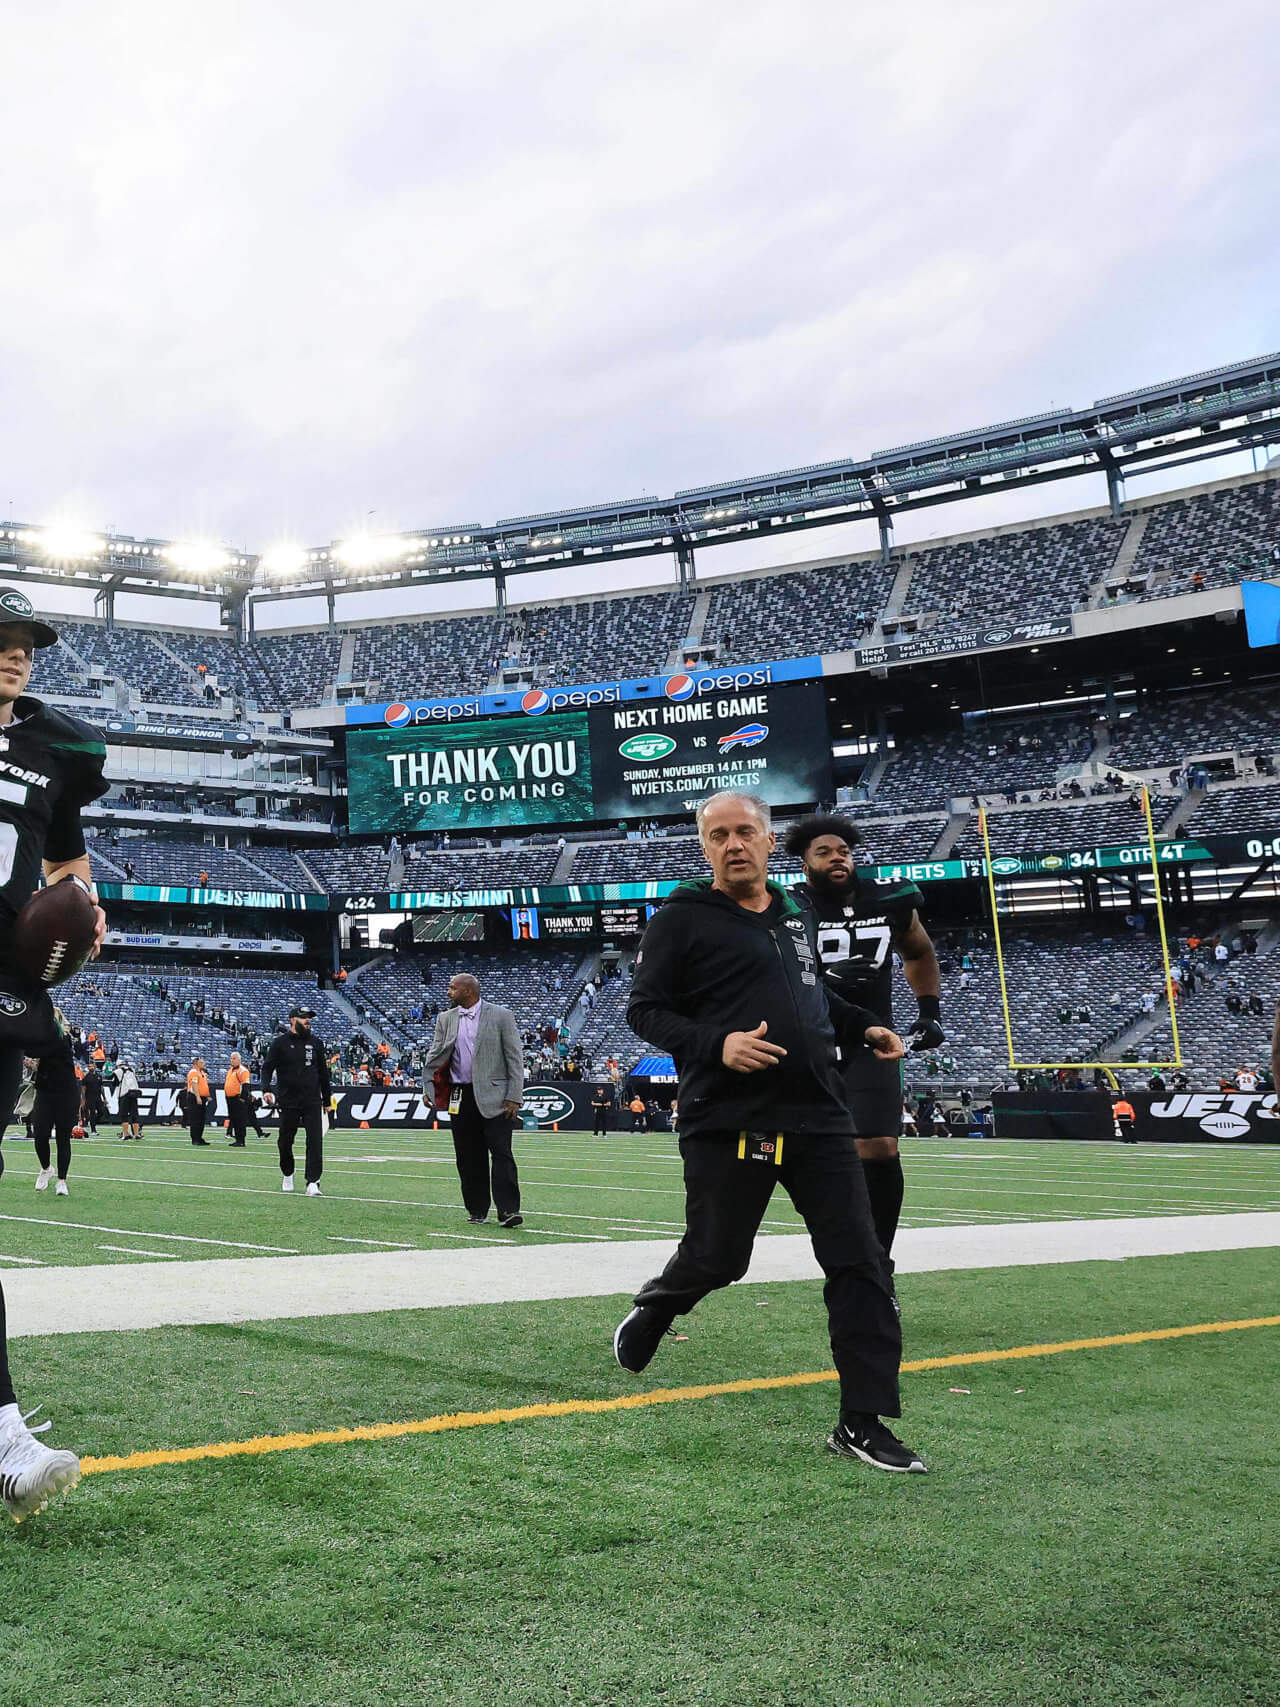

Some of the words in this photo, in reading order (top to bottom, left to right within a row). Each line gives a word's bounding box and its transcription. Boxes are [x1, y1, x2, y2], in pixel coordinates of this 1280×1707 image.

[1013, 622, 1052, 635] FANS
[1025, 625, 1070, 639] FIRST
[861, 647, 885, 657] Need
[899, 644, 916, 652] Text
[909, 649, 924, 657] call
[925, 640, 977, 655] 201.559.1515
[862, 653, 889, 664] Help?
[697, 665, 772, 696] pepsi
[551, 683, 621, 710] pepsi
[415, 699, 480, 724] pepsi
[613, 708, 659, 730] NEXT
[662, 702, 713, 725] HOME
[717, 695, 770, 719] GAME
[136, 724, 166, 735] RING
[166, 727, 181, 736] OF
[181, 728, 224, 740] HONOR
[626, 741, 670, 753] JETS
[692, 736, 707, 748] VS
[386, 745, 501, 788] THANK
[507, 739, 578, 780] YOU
[623, 767, 661, 781] SUNDAY,
[663, 763, 715, 779] NOVEMBER
[717, 762, 730, 773] 14
[731, 760, 744, 771] AT
[746, 757, 767, 770] 1PM
[631, 772, 761, 796] NYJETS.COM/TICKETS
[402, 790, 450, 807] FOR
[463, 780, 566, 803] COMING
[967, 859, 982, 867] TOL
[1070, 851, 1096, 868] 34
[1120, 848, 1154, 864] QTR
[892, 863, 946, 881] #JETS
[971, 867, 980, 877] 2
[207, 889, 244, 907] JETS
[344, 896, 377, 910] 4:24
[421, 891, 463, 908] JETS
[544, 917, 575, 929] THANK
[576, 916, 593, 928] YOU
[848, 915, 887, 928] YORK
[126, 936, 141, 944] BUD
[141, 937, 161, 945] LIGHT
[238, 941, 262, 950] pepsi
[518, 1100, 566, 1111] JETS
[1150, 1094, 1280, 1119] JETS
